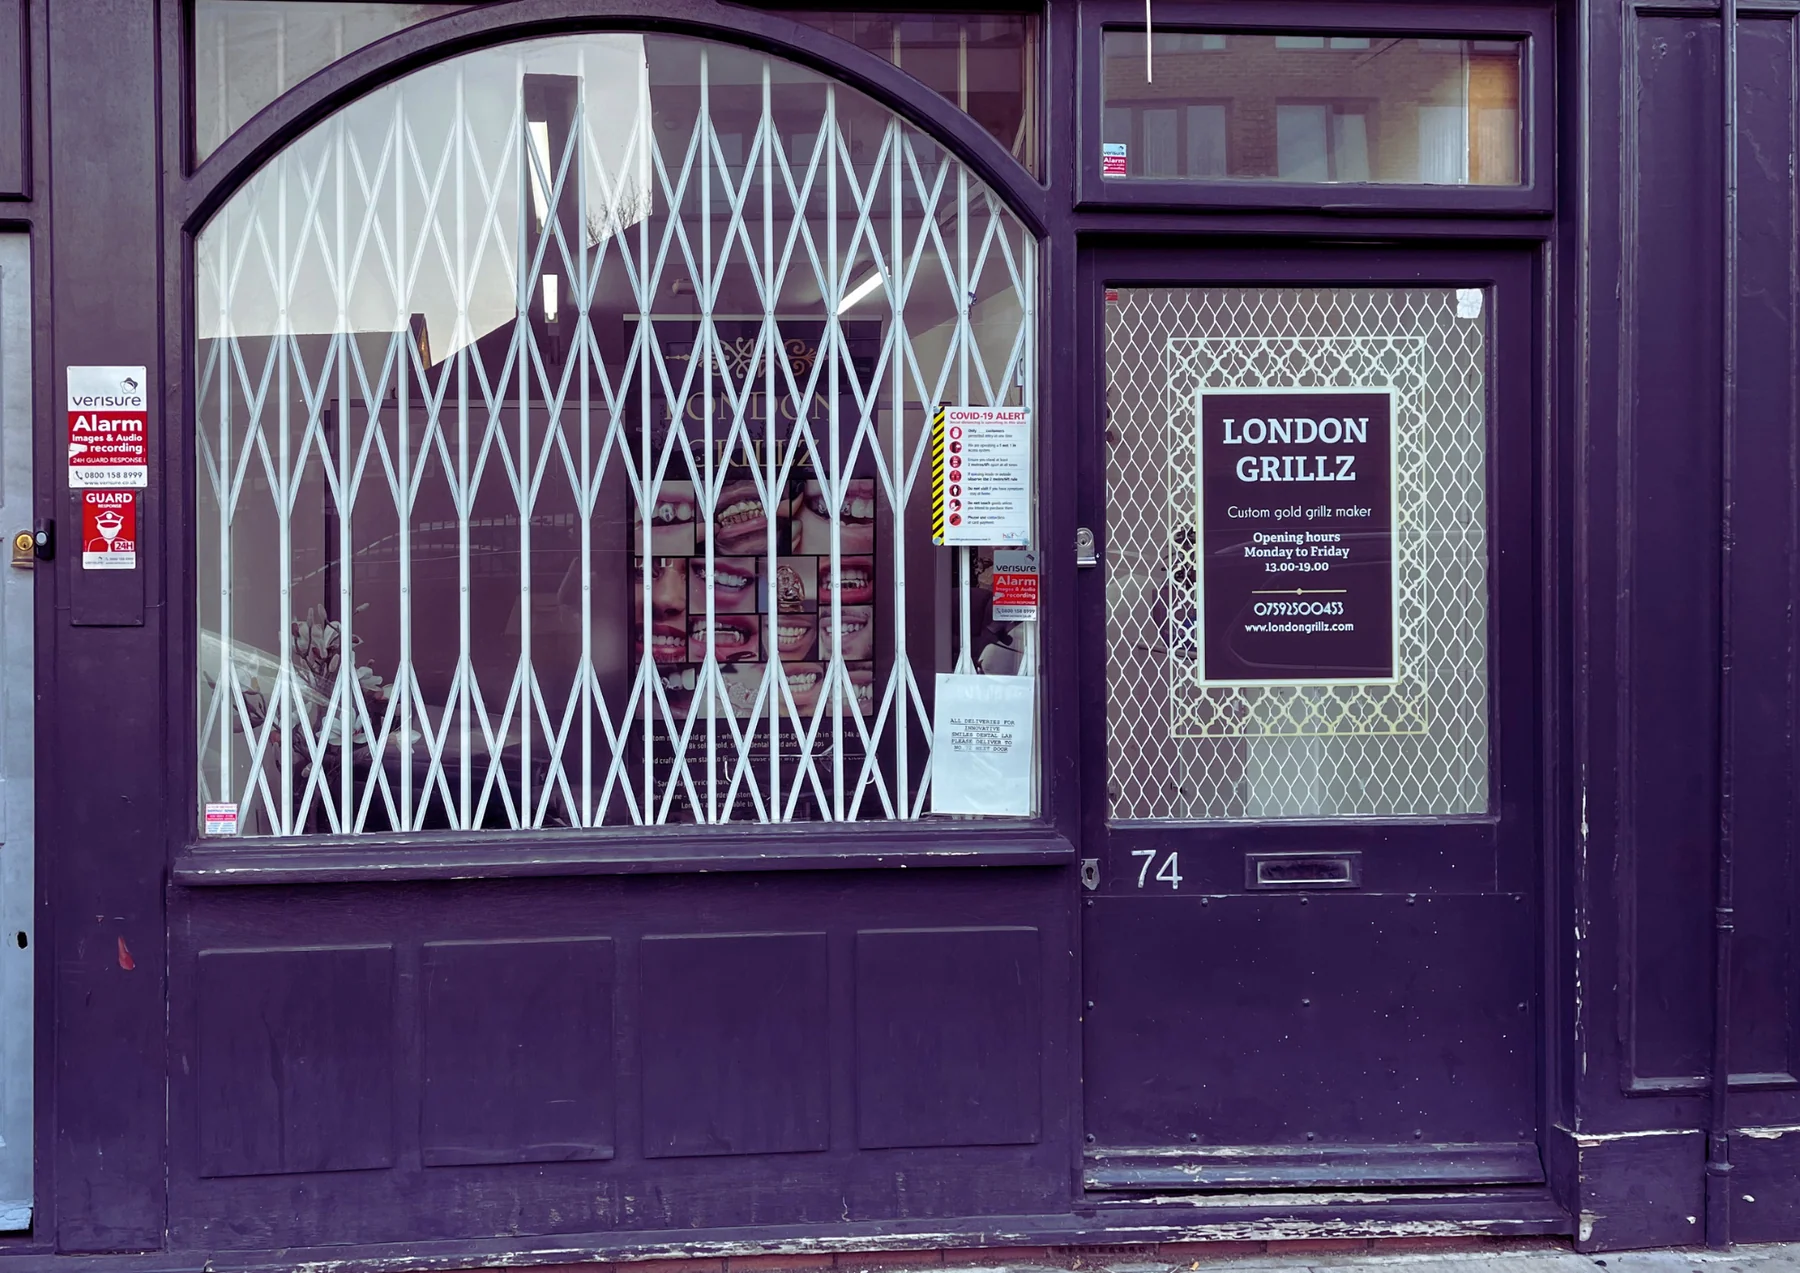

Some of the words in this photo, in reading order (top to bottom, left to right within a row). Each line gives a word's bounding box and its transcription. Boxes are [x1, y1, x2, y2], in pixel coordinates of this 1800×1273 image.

[72, 396, 142, 407] verisure
[950, 412, 994, 420] COVID-19
[996, 412, 1026, 420] ALERT
[72, 414, 143, 432] Alarm
[1222, 417, 1370, 445] LONDON
[72, 434, 104, 443] Images
[116, 434, 143, 442] Audio
[90, 442, 143, 455] recording
[1235, 455, 1356, 482] GRILLZ
[85, 493, 133, 503] GUARD
[1228, 505, 1270, 519] Custom
[1274, 505, 1302, 520] gold
[1306, 505, 1332, 520] grillz
[1336, 505, 1372, 517] maker
[1253, 532, 1303, 545] Opening
[1306, 531, 1341, 543] hours
[1244, 546, 1293, 559] Monday
[1296, 547, 1308, 557] to
[1310, 546, 1350, 559] Friday
[1265, 562, 1329, 572] 13.00-19.00
[996, 575, 1036, 586] Alarm
[1006, 592, 1036, 600] recording
[1254, 601, 1344, 616] 07592500453
[1245, 621, 1354, 634] www.londongrillz.com
[1131, 850, 1183, 889] 74
